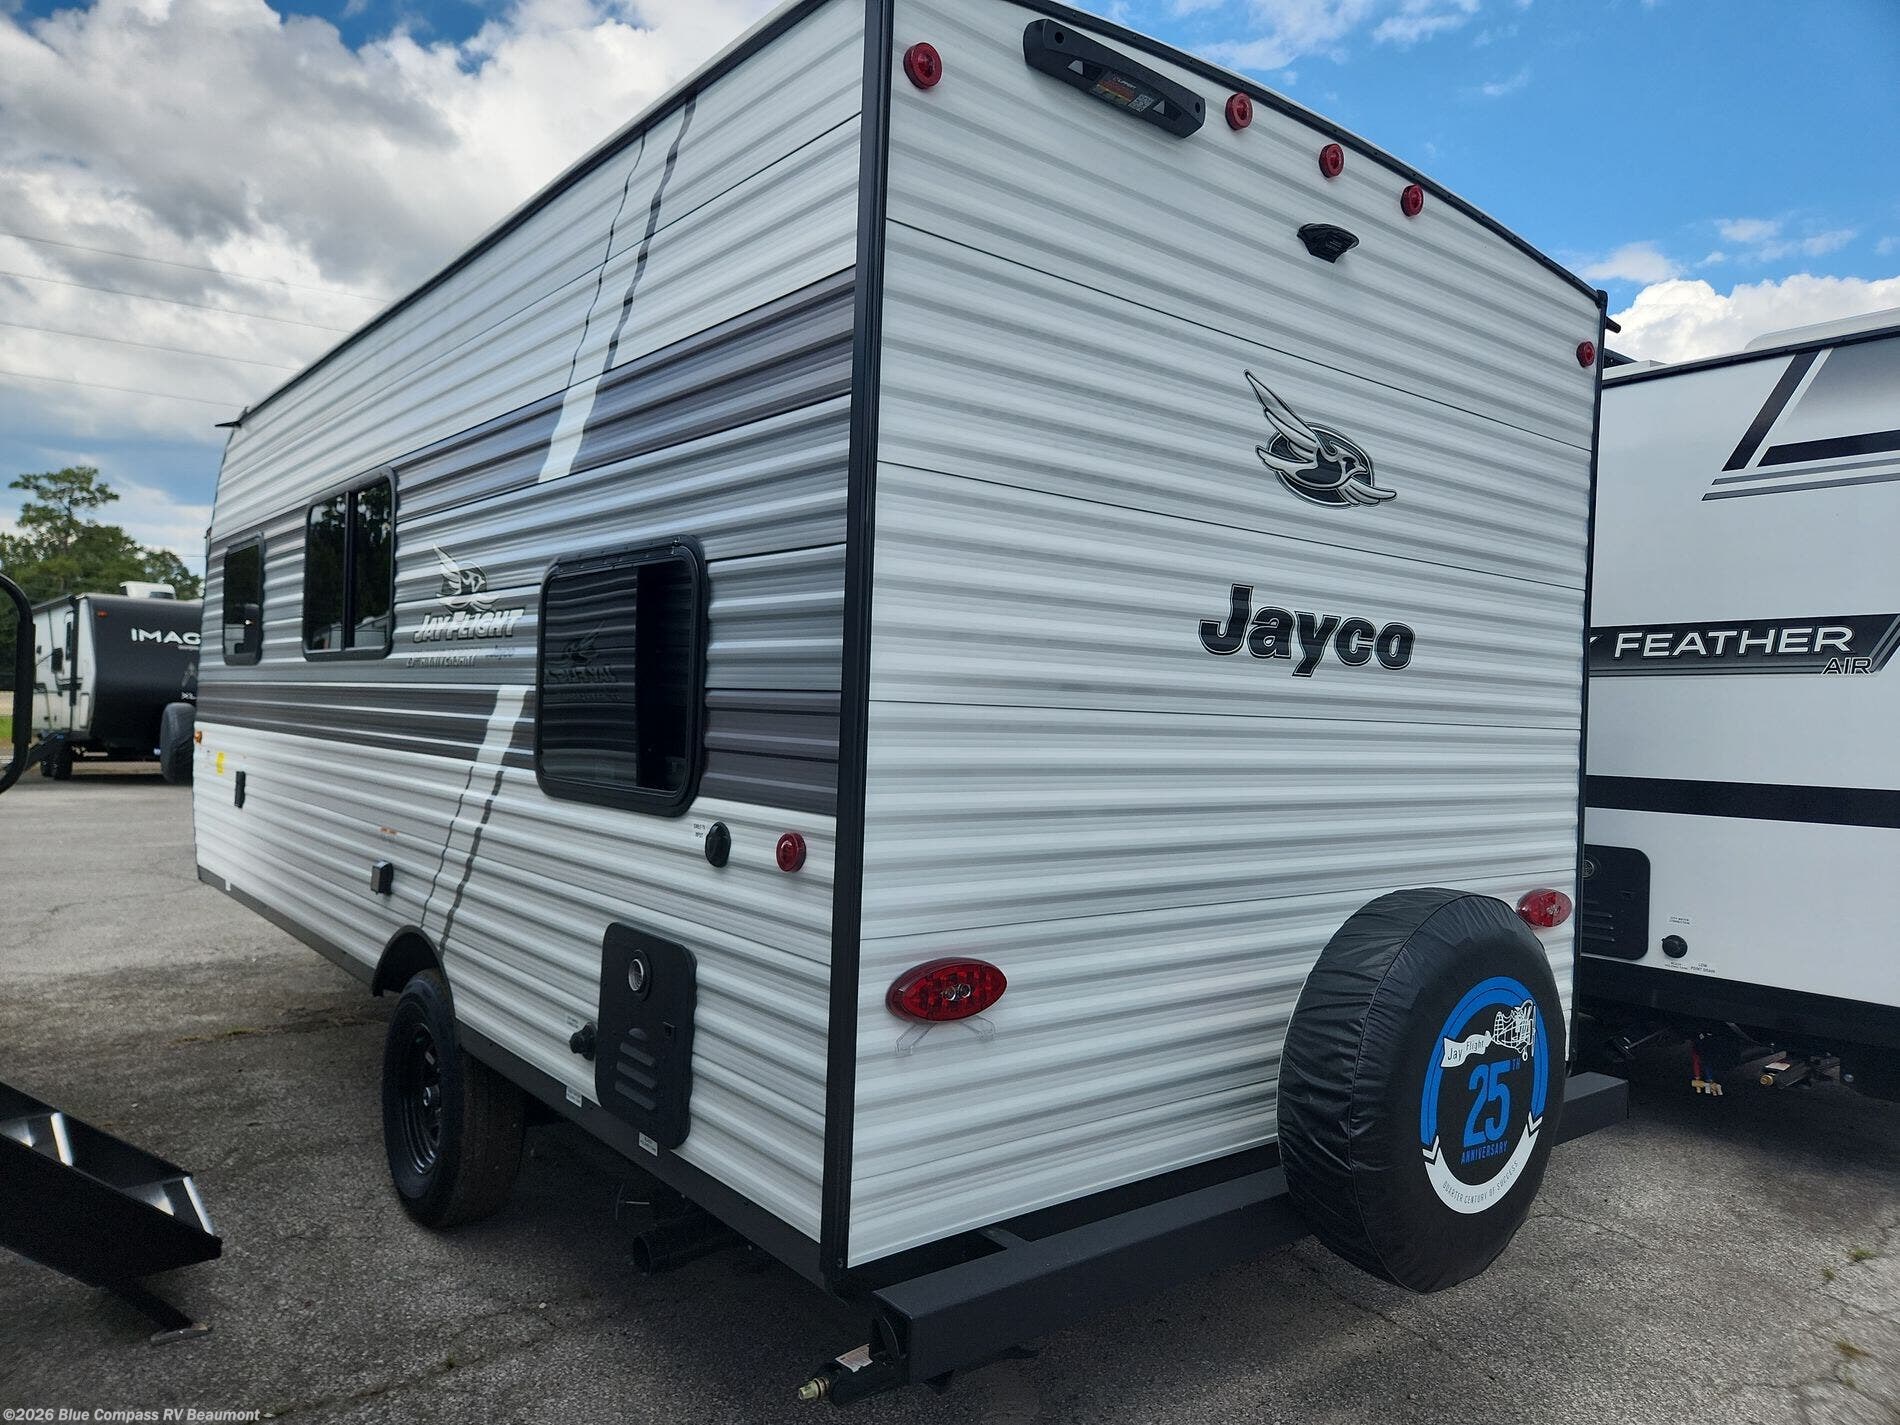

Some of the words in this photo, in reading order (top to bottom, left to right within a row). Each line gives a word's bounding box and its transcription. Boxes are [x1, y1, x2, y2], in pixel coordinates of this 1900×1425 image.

[1198, 583, 1416, 677] Jayco
[1614, 626, 1855, 658] FEATHER
[1821, 657, 1873, 675] AIR
[1447, 1047, 1463, 1061] Jay
[1466, 1040, 1485, 1052] Flight
[1463, 1059, 1511, 1148] 25
[1460, 1140, 1508, 1165] ANNIVERSARY
